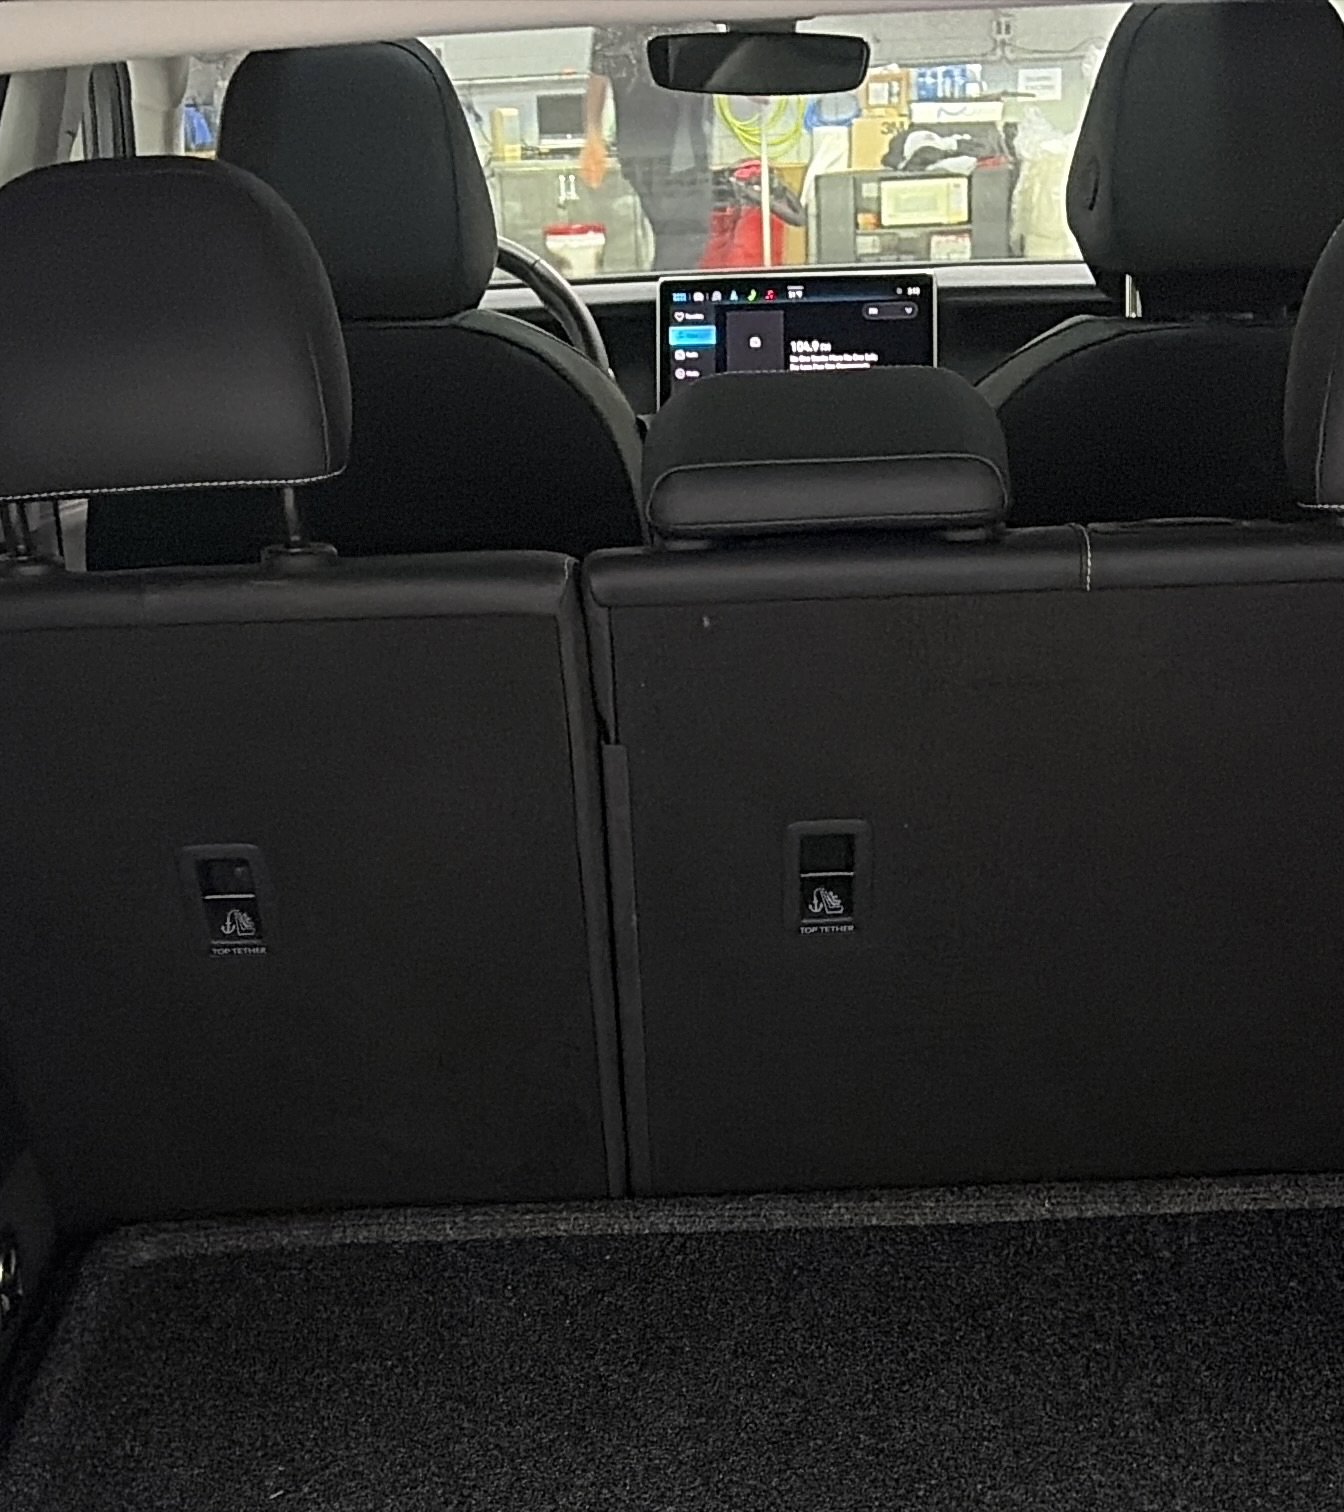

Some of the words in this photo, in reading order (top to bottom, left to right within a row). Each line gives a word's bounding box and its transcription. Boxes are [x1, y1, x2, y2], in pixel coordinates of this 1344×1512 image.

[800, 926, 817, 934] TOP
[820, 925, 854, 933] TETHER
[233, 947, 267, 955] TETHER
